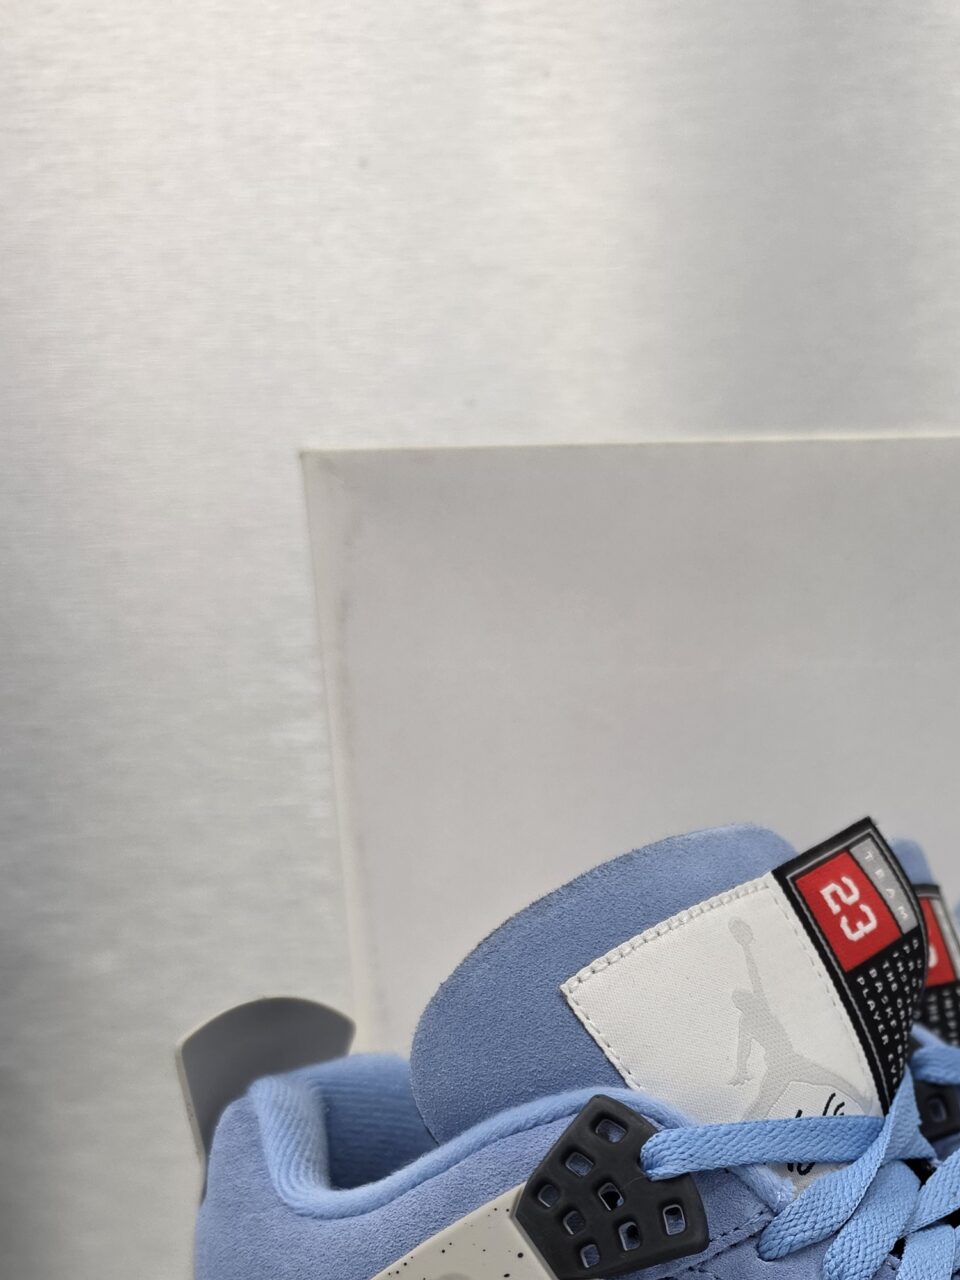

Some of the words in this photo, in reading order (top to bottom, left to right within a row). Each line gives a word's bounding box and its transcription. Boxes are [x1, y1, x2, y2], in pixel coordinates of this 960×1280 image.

[820, 876, 877, 942] 23
[865, 851, 908, 919] TEAM
[882, 960, 898, 992] THE
[856, 976, 888, 1045] PLAYER
